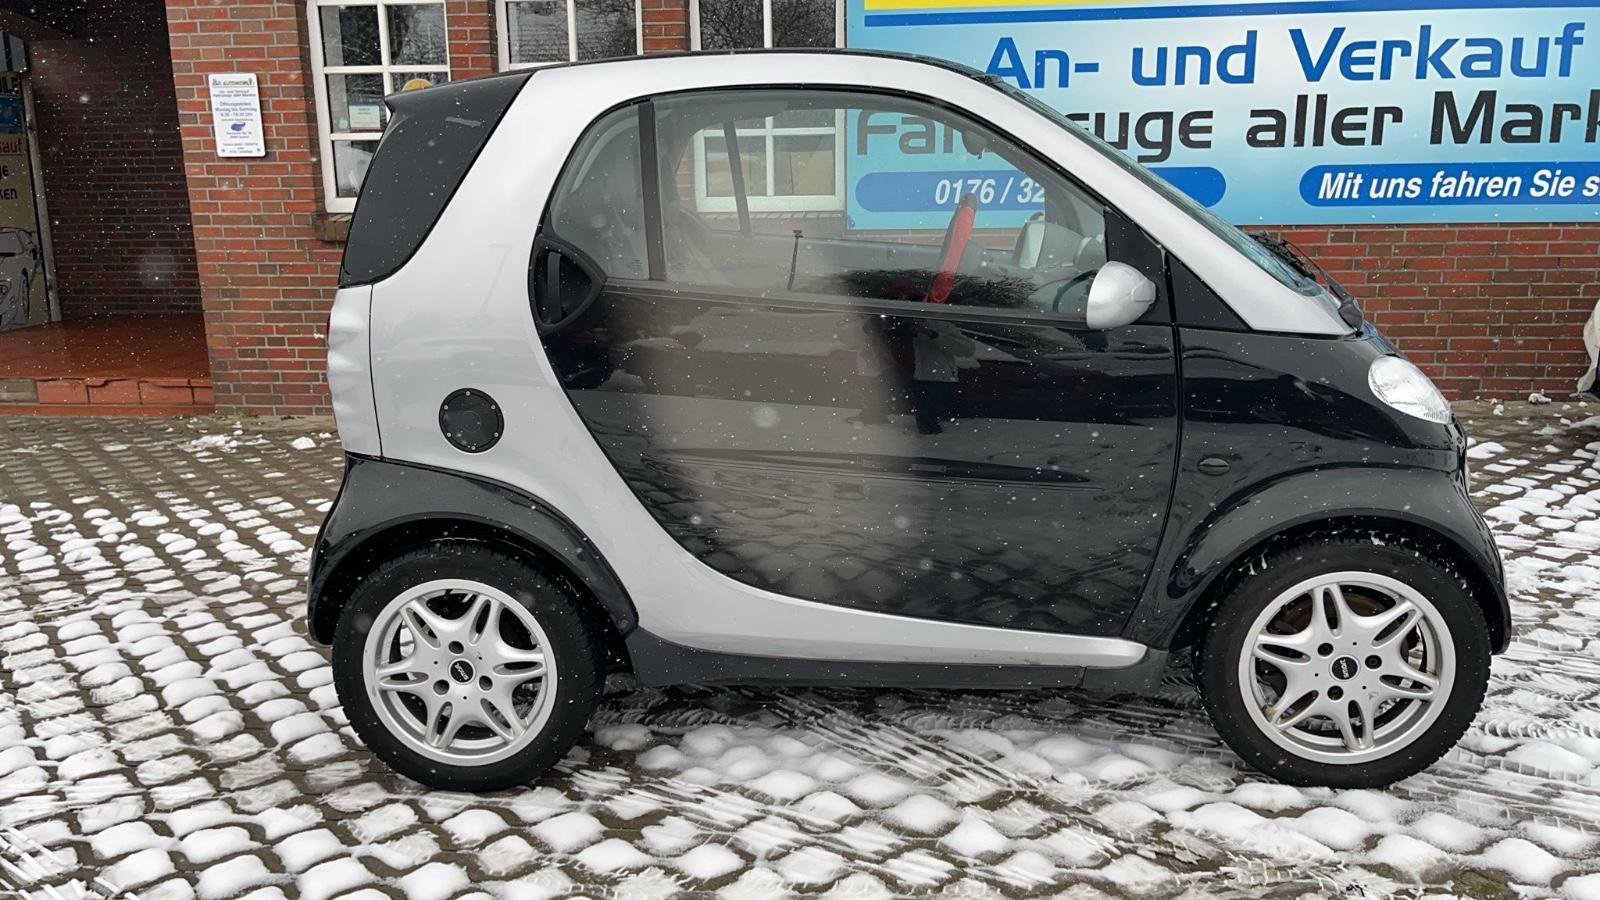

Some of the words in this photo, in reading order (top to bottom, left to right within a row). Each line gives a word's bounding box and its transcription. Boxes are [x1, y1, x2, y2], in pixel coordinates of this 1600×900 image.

[985, 37, 1099, 89] An-
[1131, 30, 1258, 87] und
[1288, 22, 1586, 83] Verkauf
[1245, 93, 1404, 148] aller
[934, 178, 997, 205] 0176
[1318, 172, 1364, 200] Mit
[1369, 177, 1423, 199] uns
[1430, 170, 1522, 199] fahren
[1529, 168, 1576, 198] Sie
